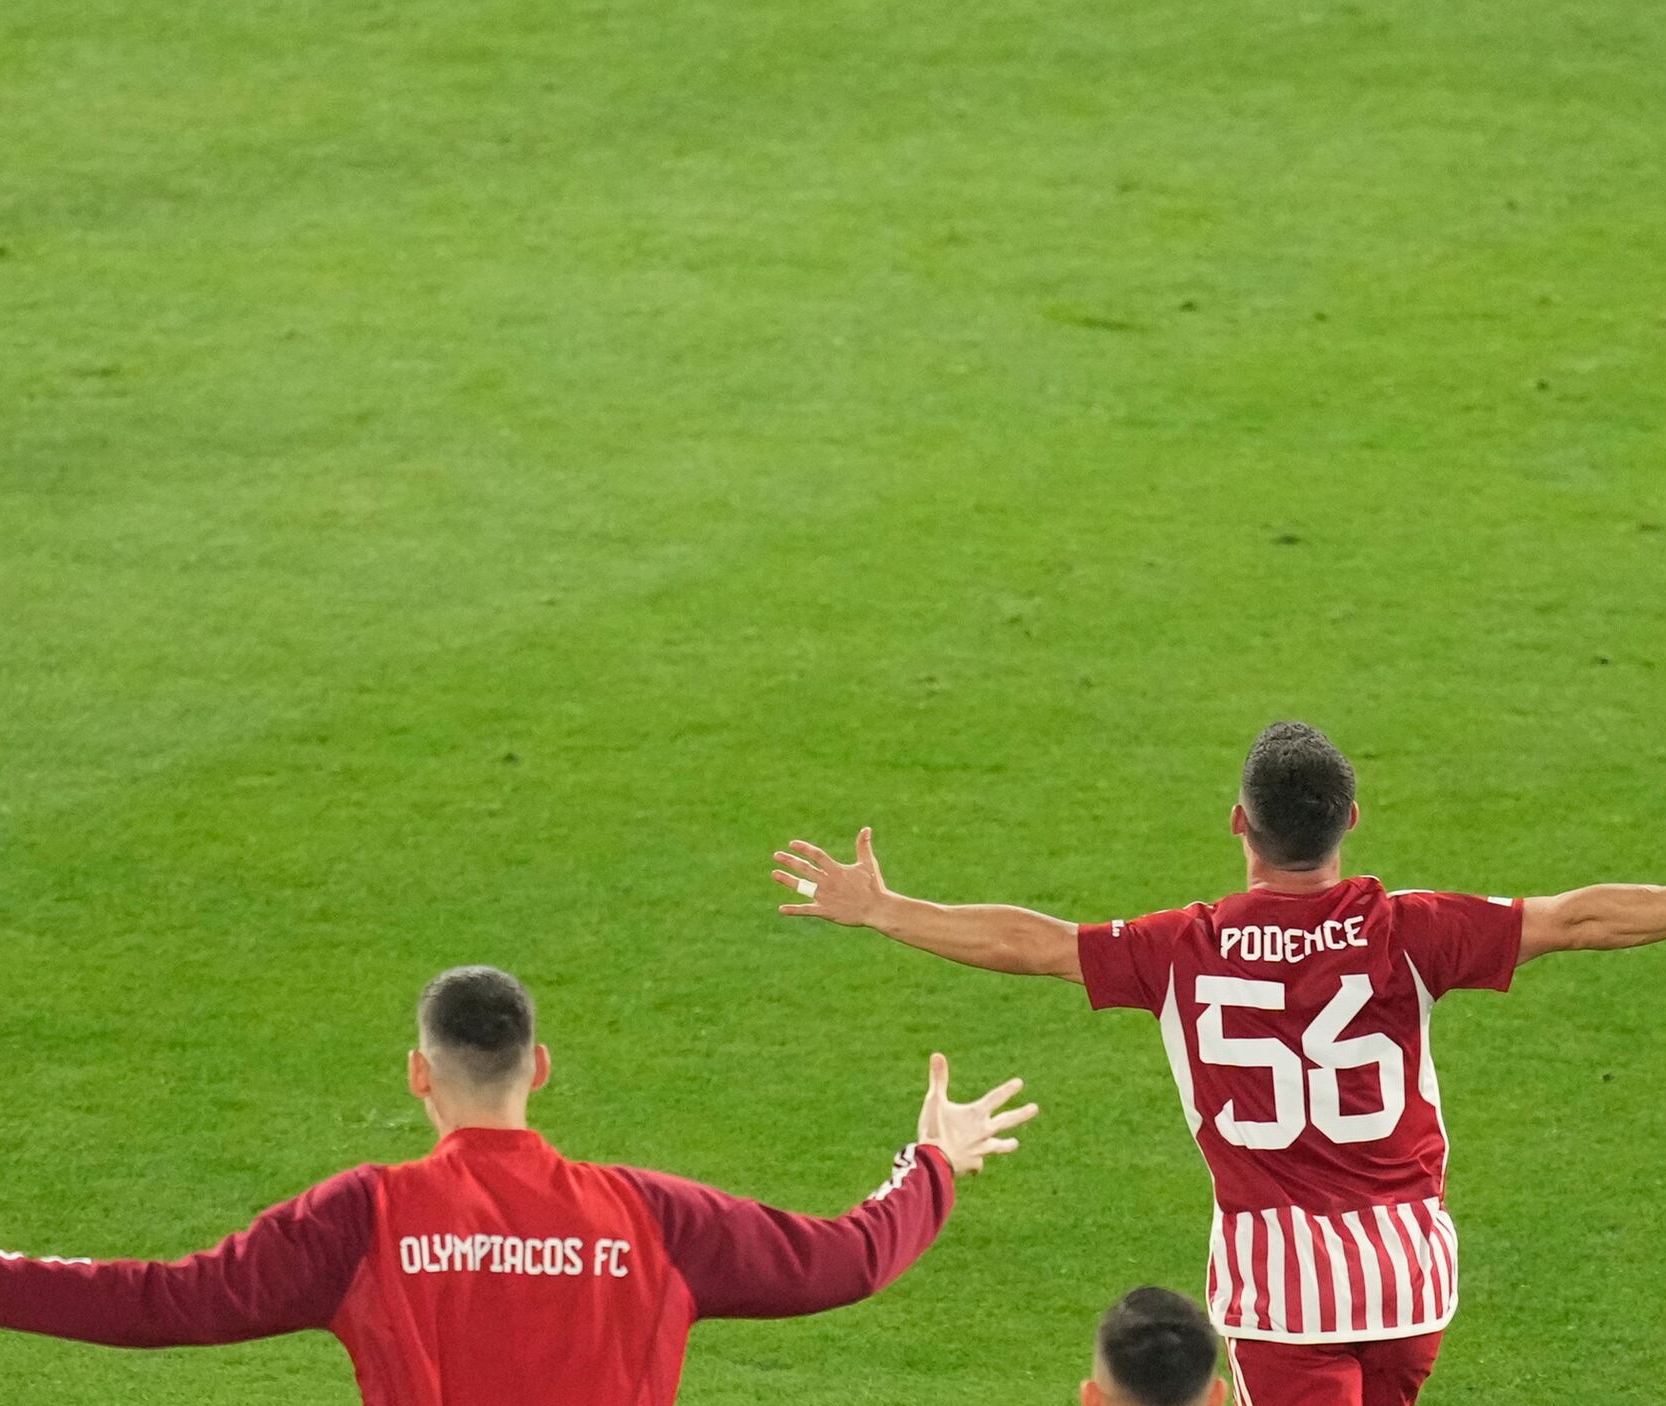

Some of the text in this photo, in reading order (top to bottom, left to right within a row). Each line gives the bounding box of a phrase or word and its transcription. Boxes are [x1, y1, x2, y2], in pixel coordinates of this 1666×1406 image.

[1220, 915, 1368, 963] PODENCE
[1194, 973, 1408, 1150] 56
[399, 1233, 631, 1277] OLYMPIACOS FC
